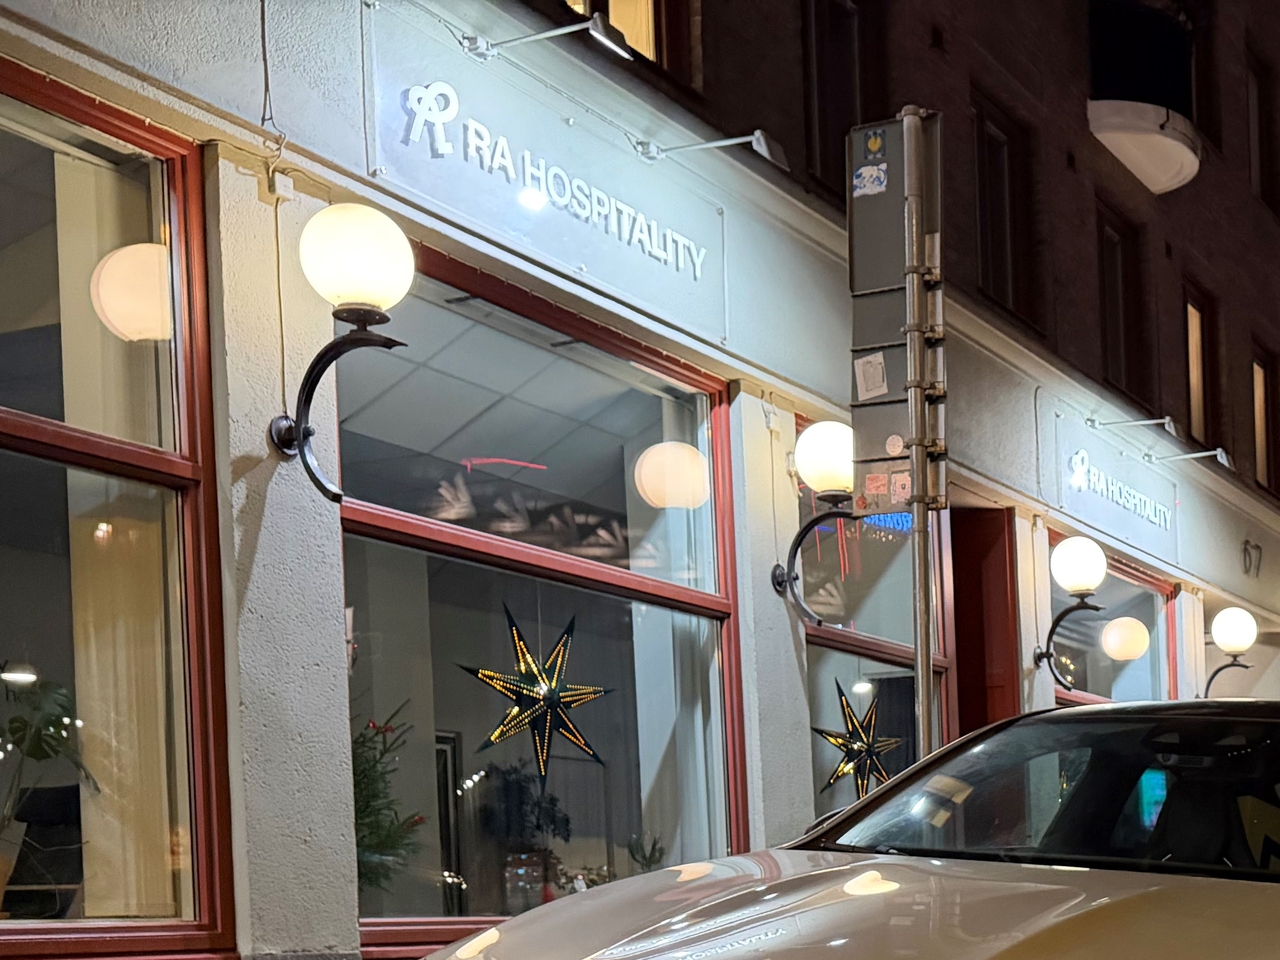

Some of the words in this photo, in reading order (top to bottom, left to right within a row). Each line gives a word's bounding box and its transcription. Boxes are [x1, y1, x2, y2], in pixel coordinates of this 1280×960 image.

[467, 117, 517, 179] RA
[522, 148, 707, 278] HOSPITALITY
[1089, 465, 1109, 497] RA
[1107, 475, 1173, 531] HOSPITALITY
[1242, 538, 1262, 578] 67
